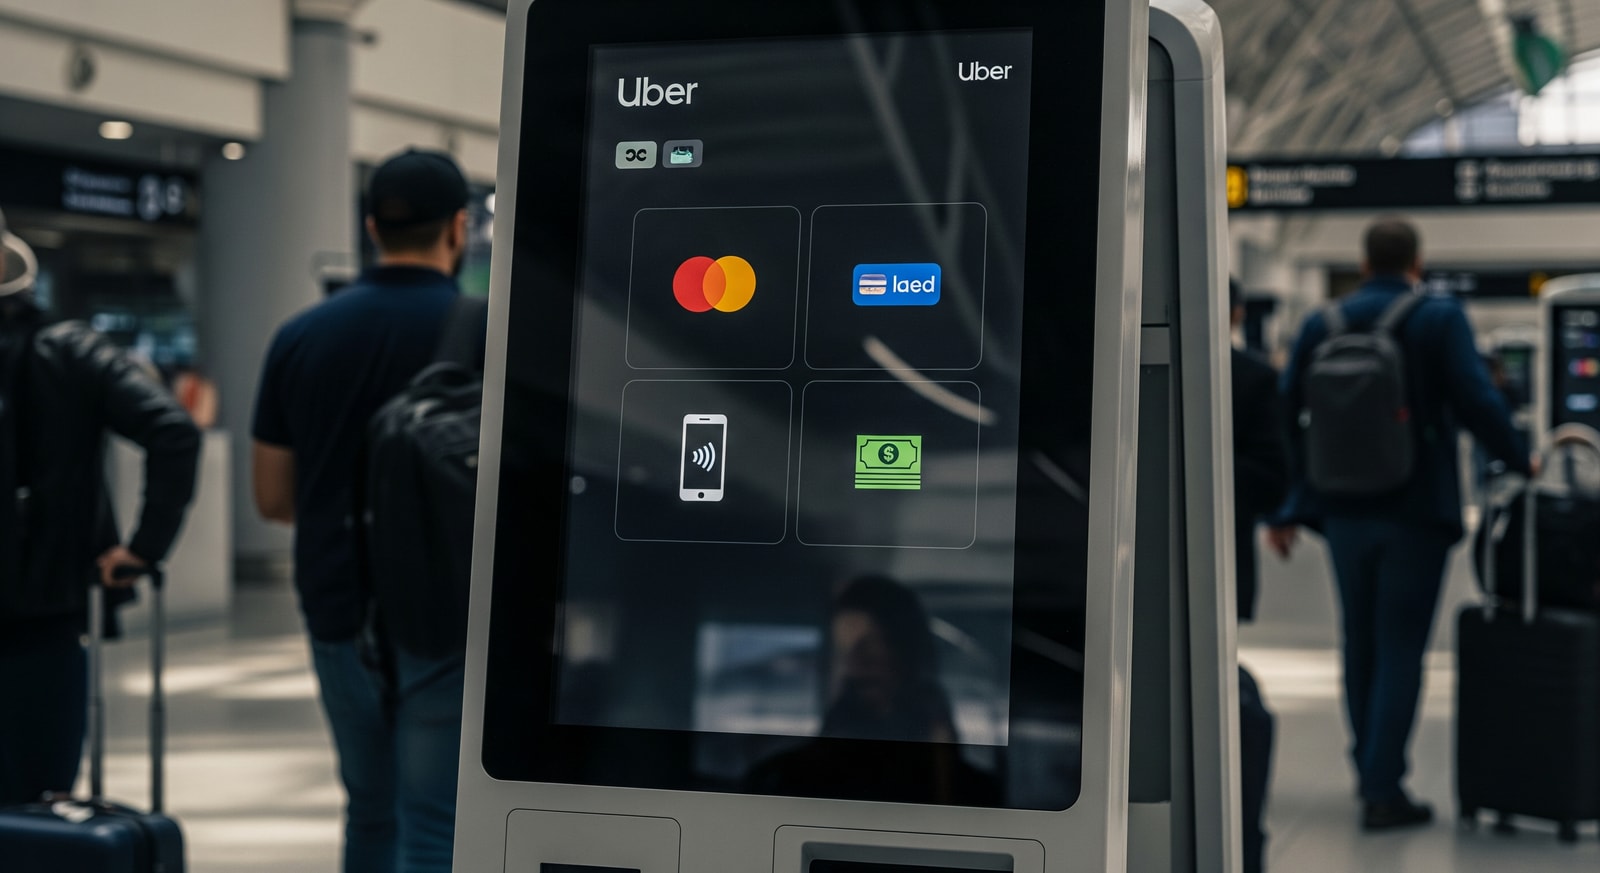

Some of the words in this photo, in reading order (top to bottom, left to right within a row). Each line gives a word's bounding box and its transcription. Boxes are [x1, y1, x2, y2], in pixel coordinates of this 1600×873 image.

[958, 61, 1013, 81] Uber
[617, 76, 699, 107] Uber
[892, 274, 936, 293] laed
